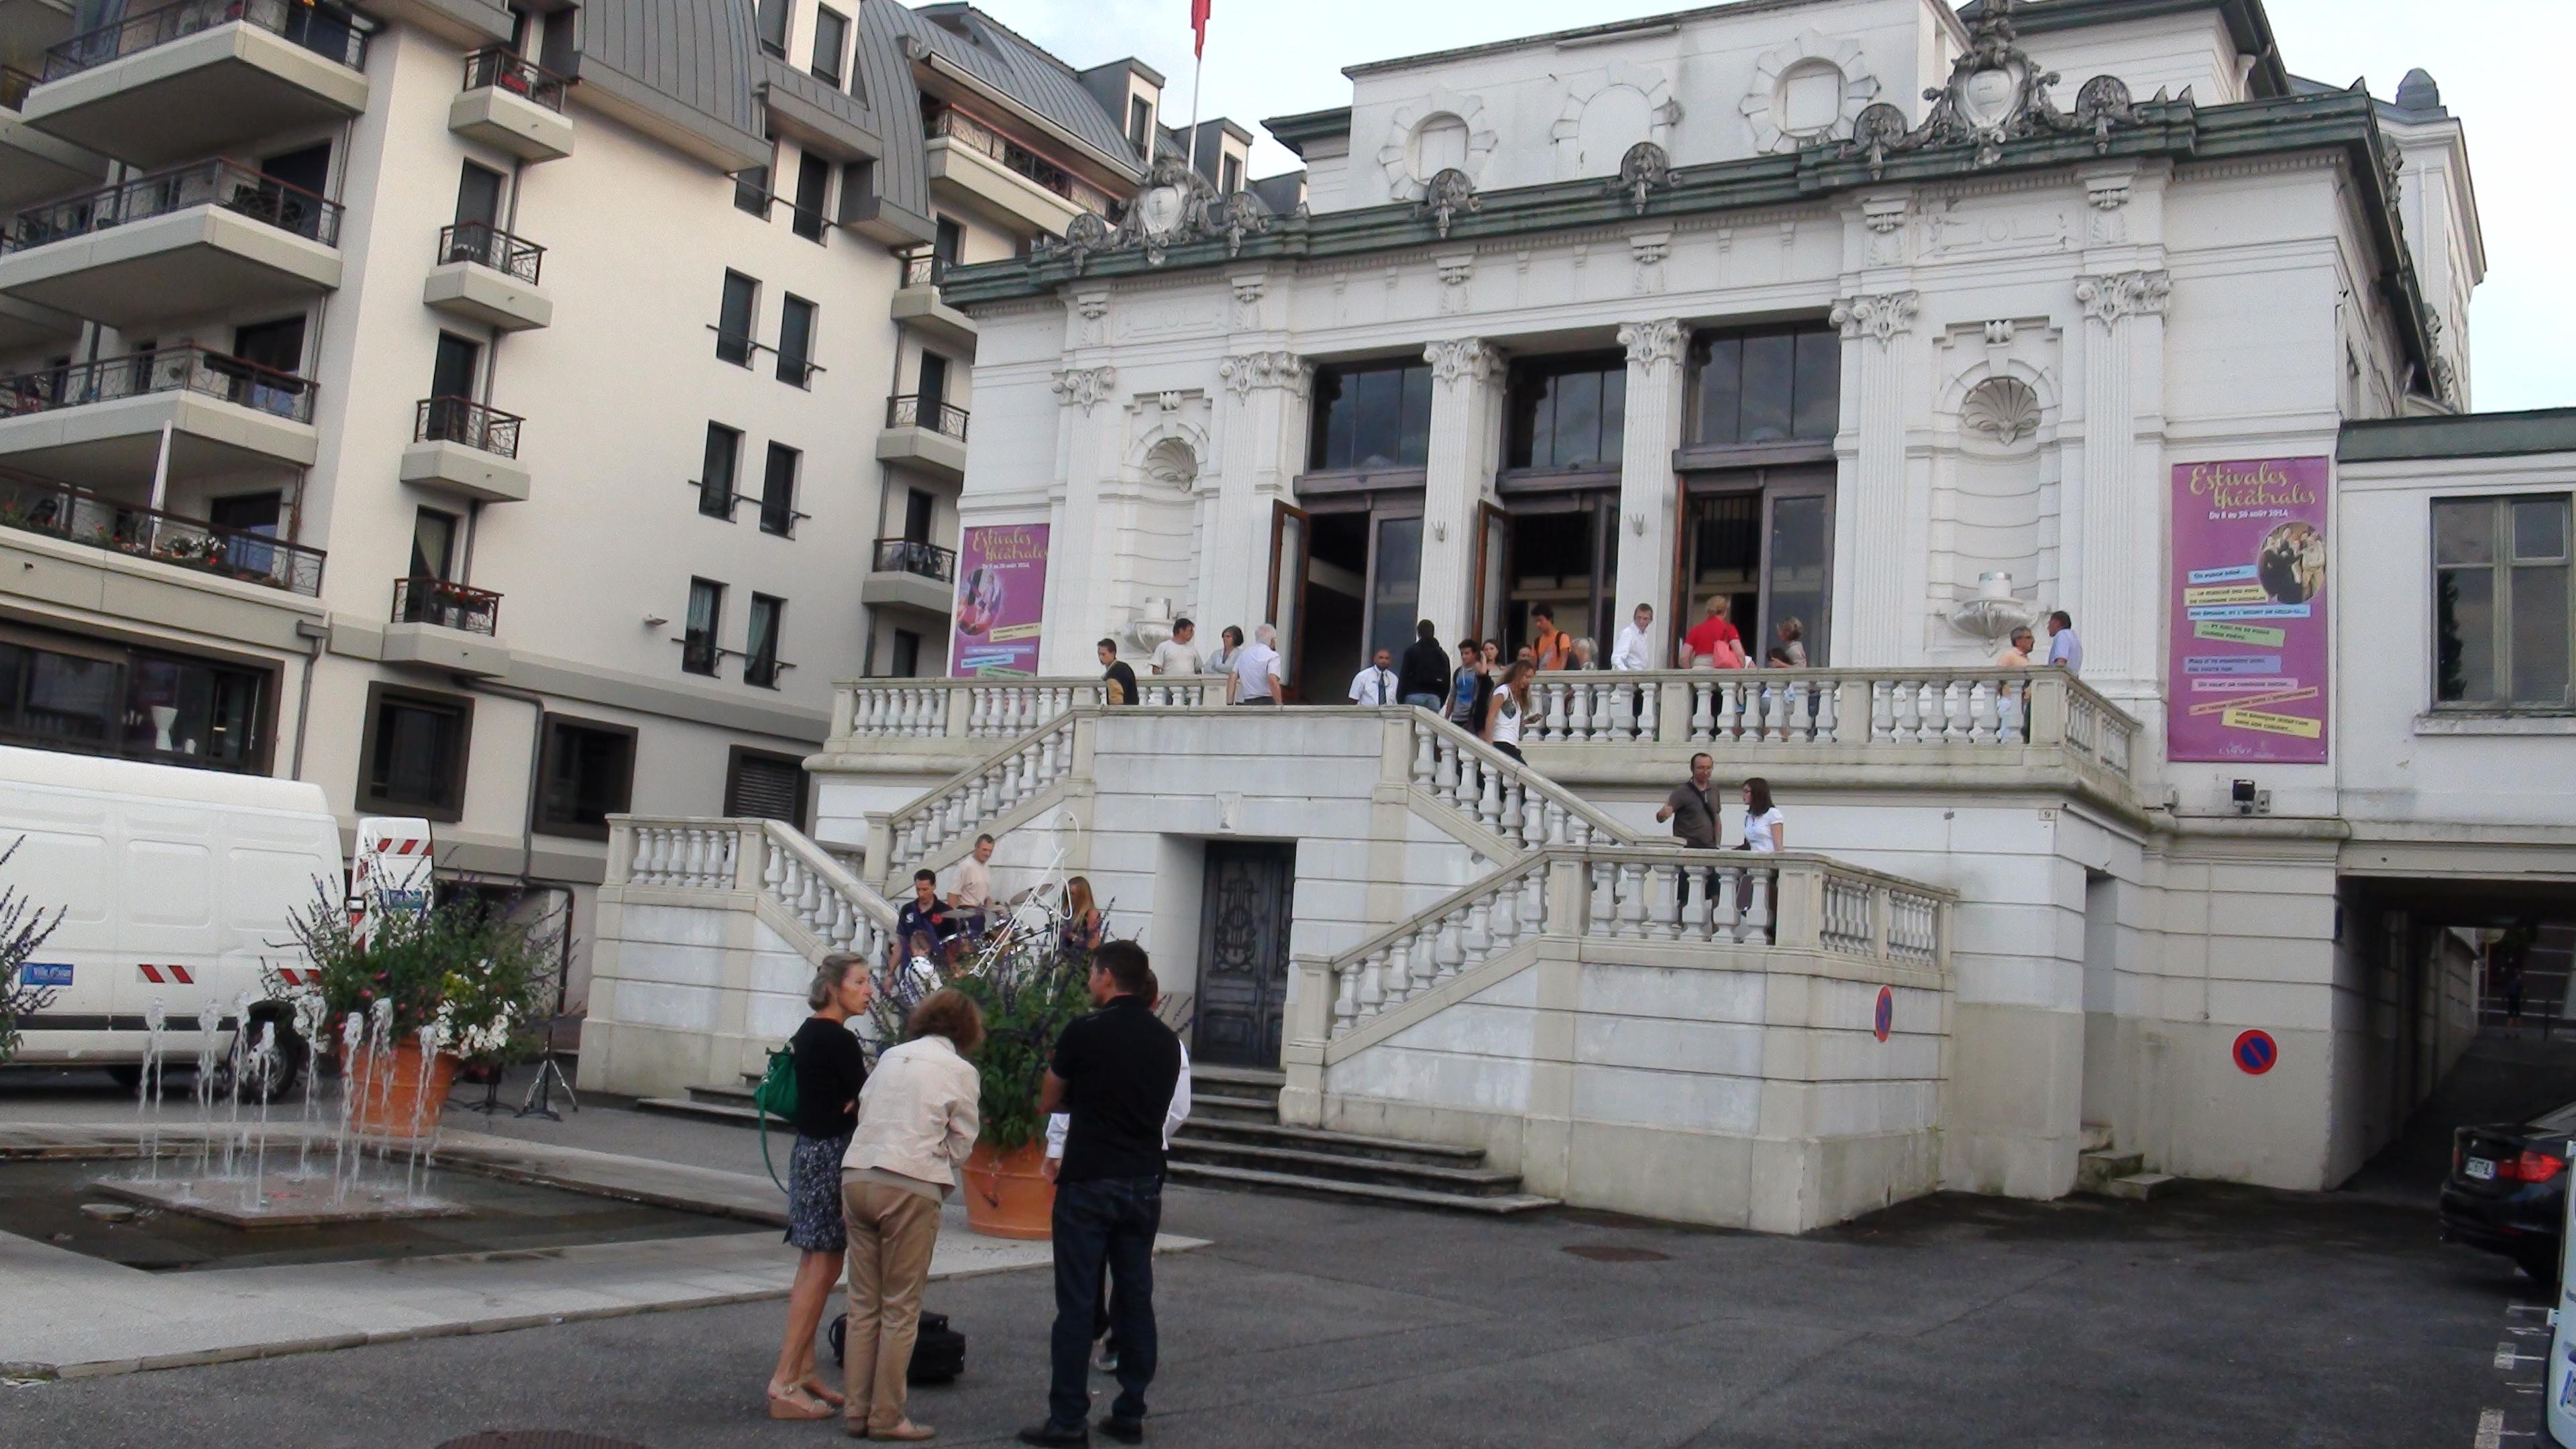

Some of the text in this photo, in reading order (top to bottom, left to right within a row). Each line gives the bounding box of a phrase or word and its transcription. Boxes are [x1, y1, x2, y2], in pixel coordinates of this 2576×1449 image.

[2190, 462, 2287, 495] Estivales
[2214, 483, 2316, 509] théâtrales
[973, 527, 1030, 551] Estivales
